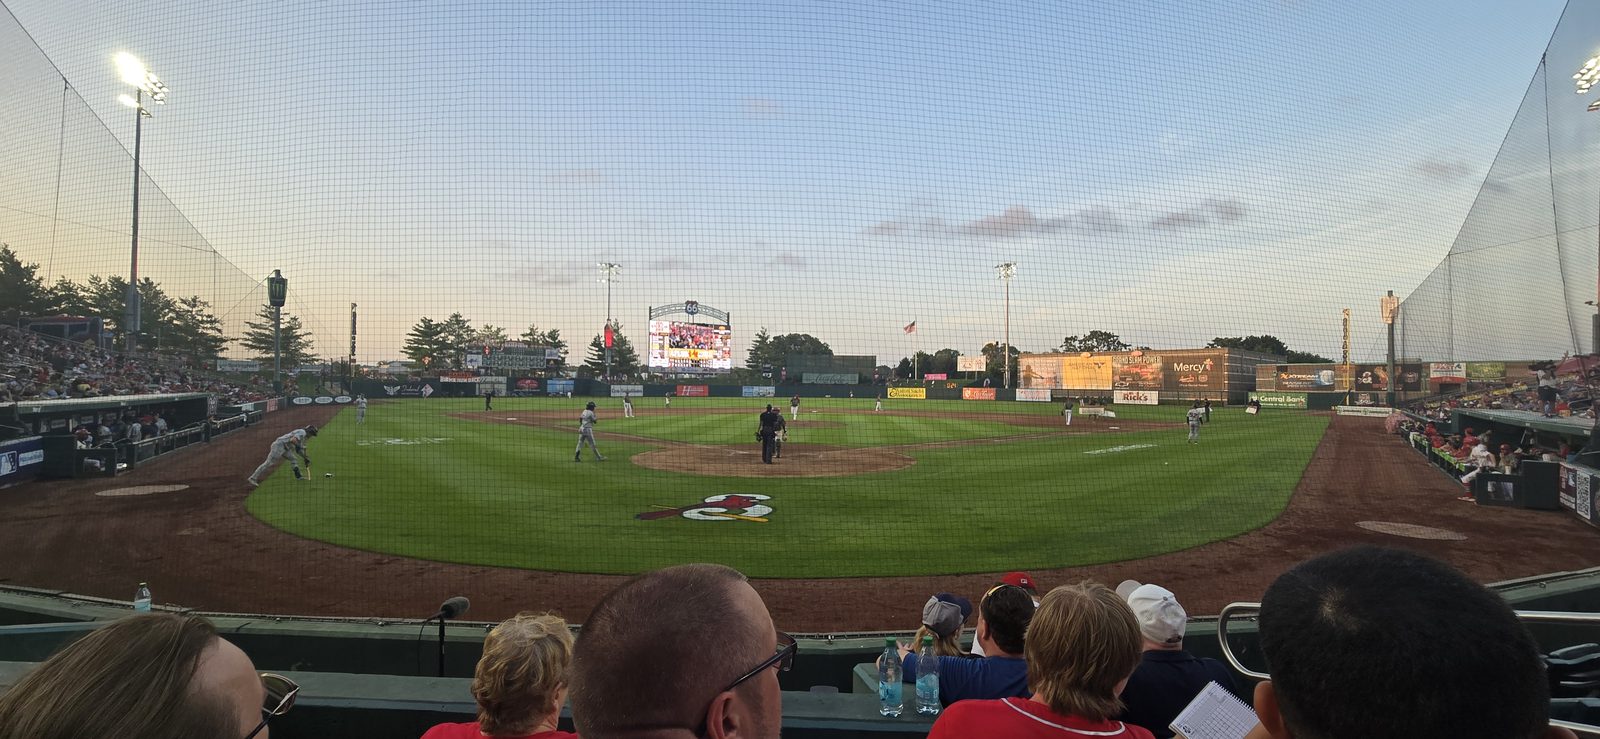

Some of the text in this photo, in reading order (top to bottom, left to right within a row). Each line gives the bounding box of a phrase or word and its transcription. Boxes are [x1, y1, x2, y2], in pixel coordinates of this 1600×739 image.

[686, 304, 698, 312] 66
[1173, 362, 1205, 373] Mercy
[1123, 391, 1148, 401] Rick's
[1260, 395, 1306, 403] Central Bank
